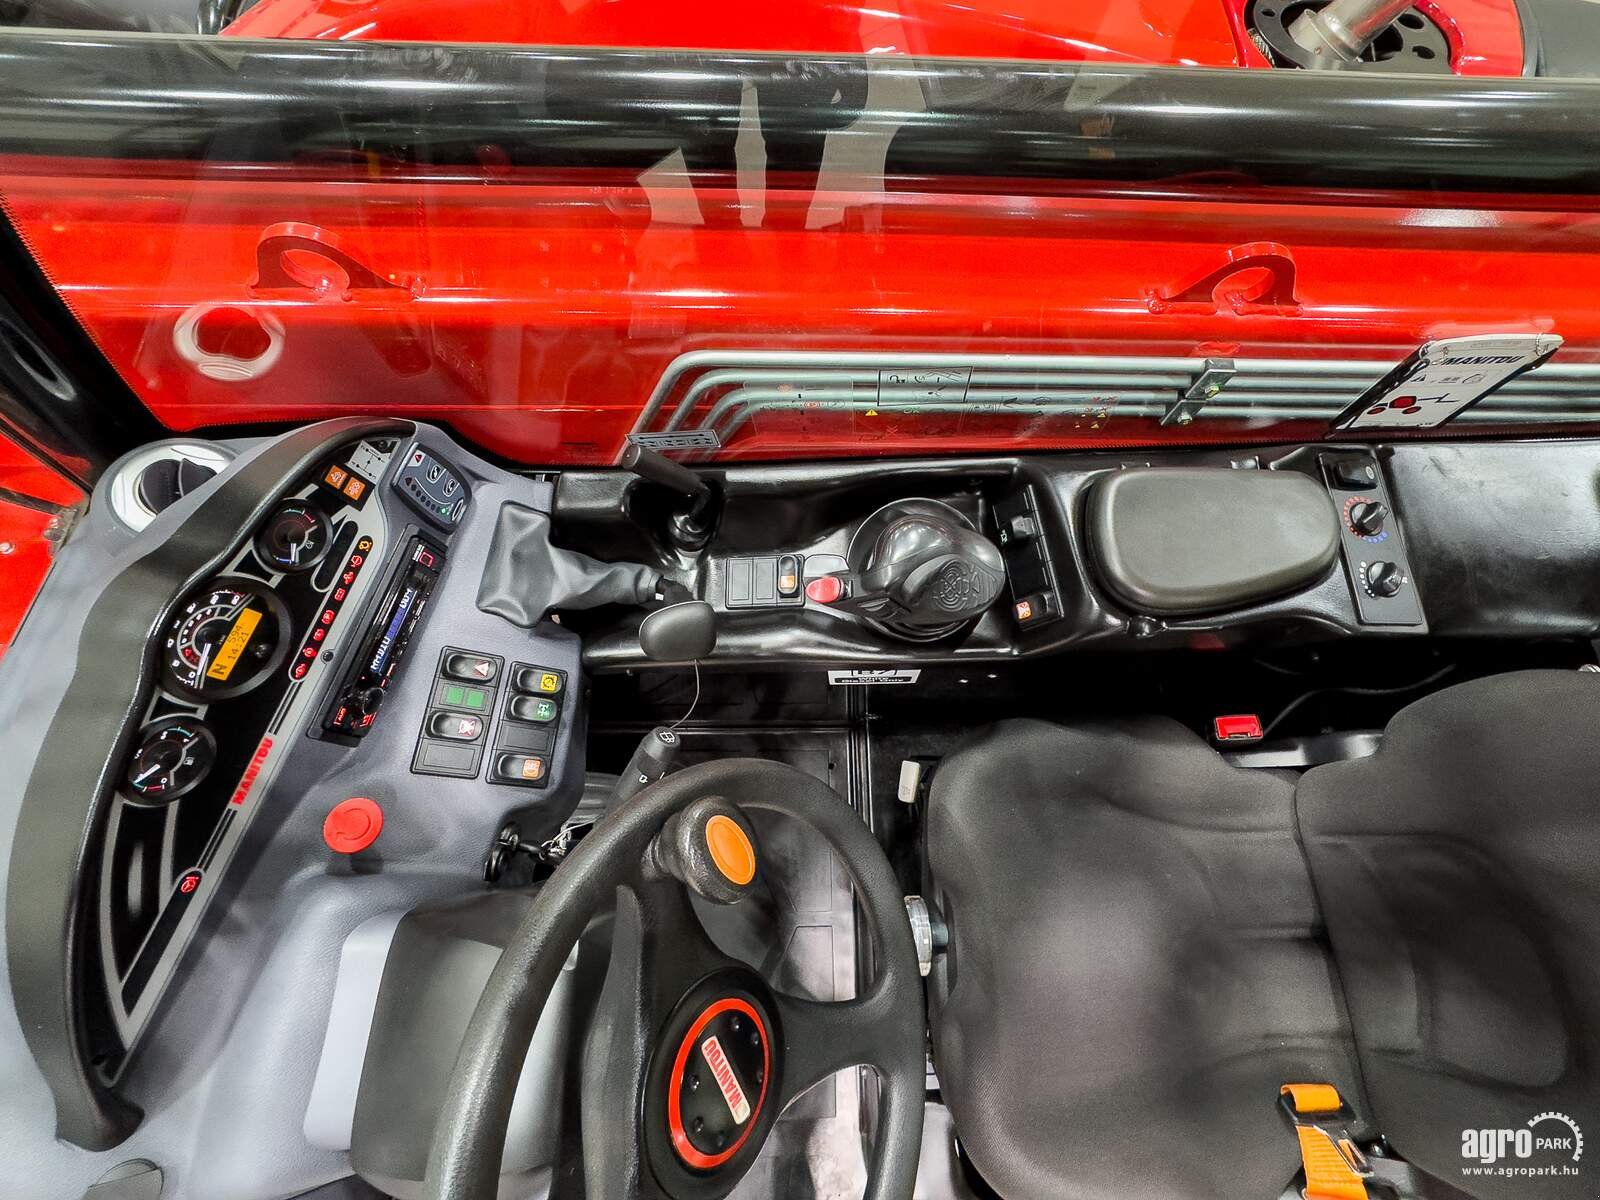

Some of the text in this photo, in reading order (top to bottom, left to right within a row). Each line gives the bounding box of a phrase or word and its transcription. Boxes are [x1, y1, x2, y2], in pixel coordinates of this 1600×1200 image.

[1441, 355, 1525, 366] MANITOU
[211, 663, 227, 676] N
[231, 737, 273, 806] MANITOU
[704, 1039, 743, 1109] MANITOU
